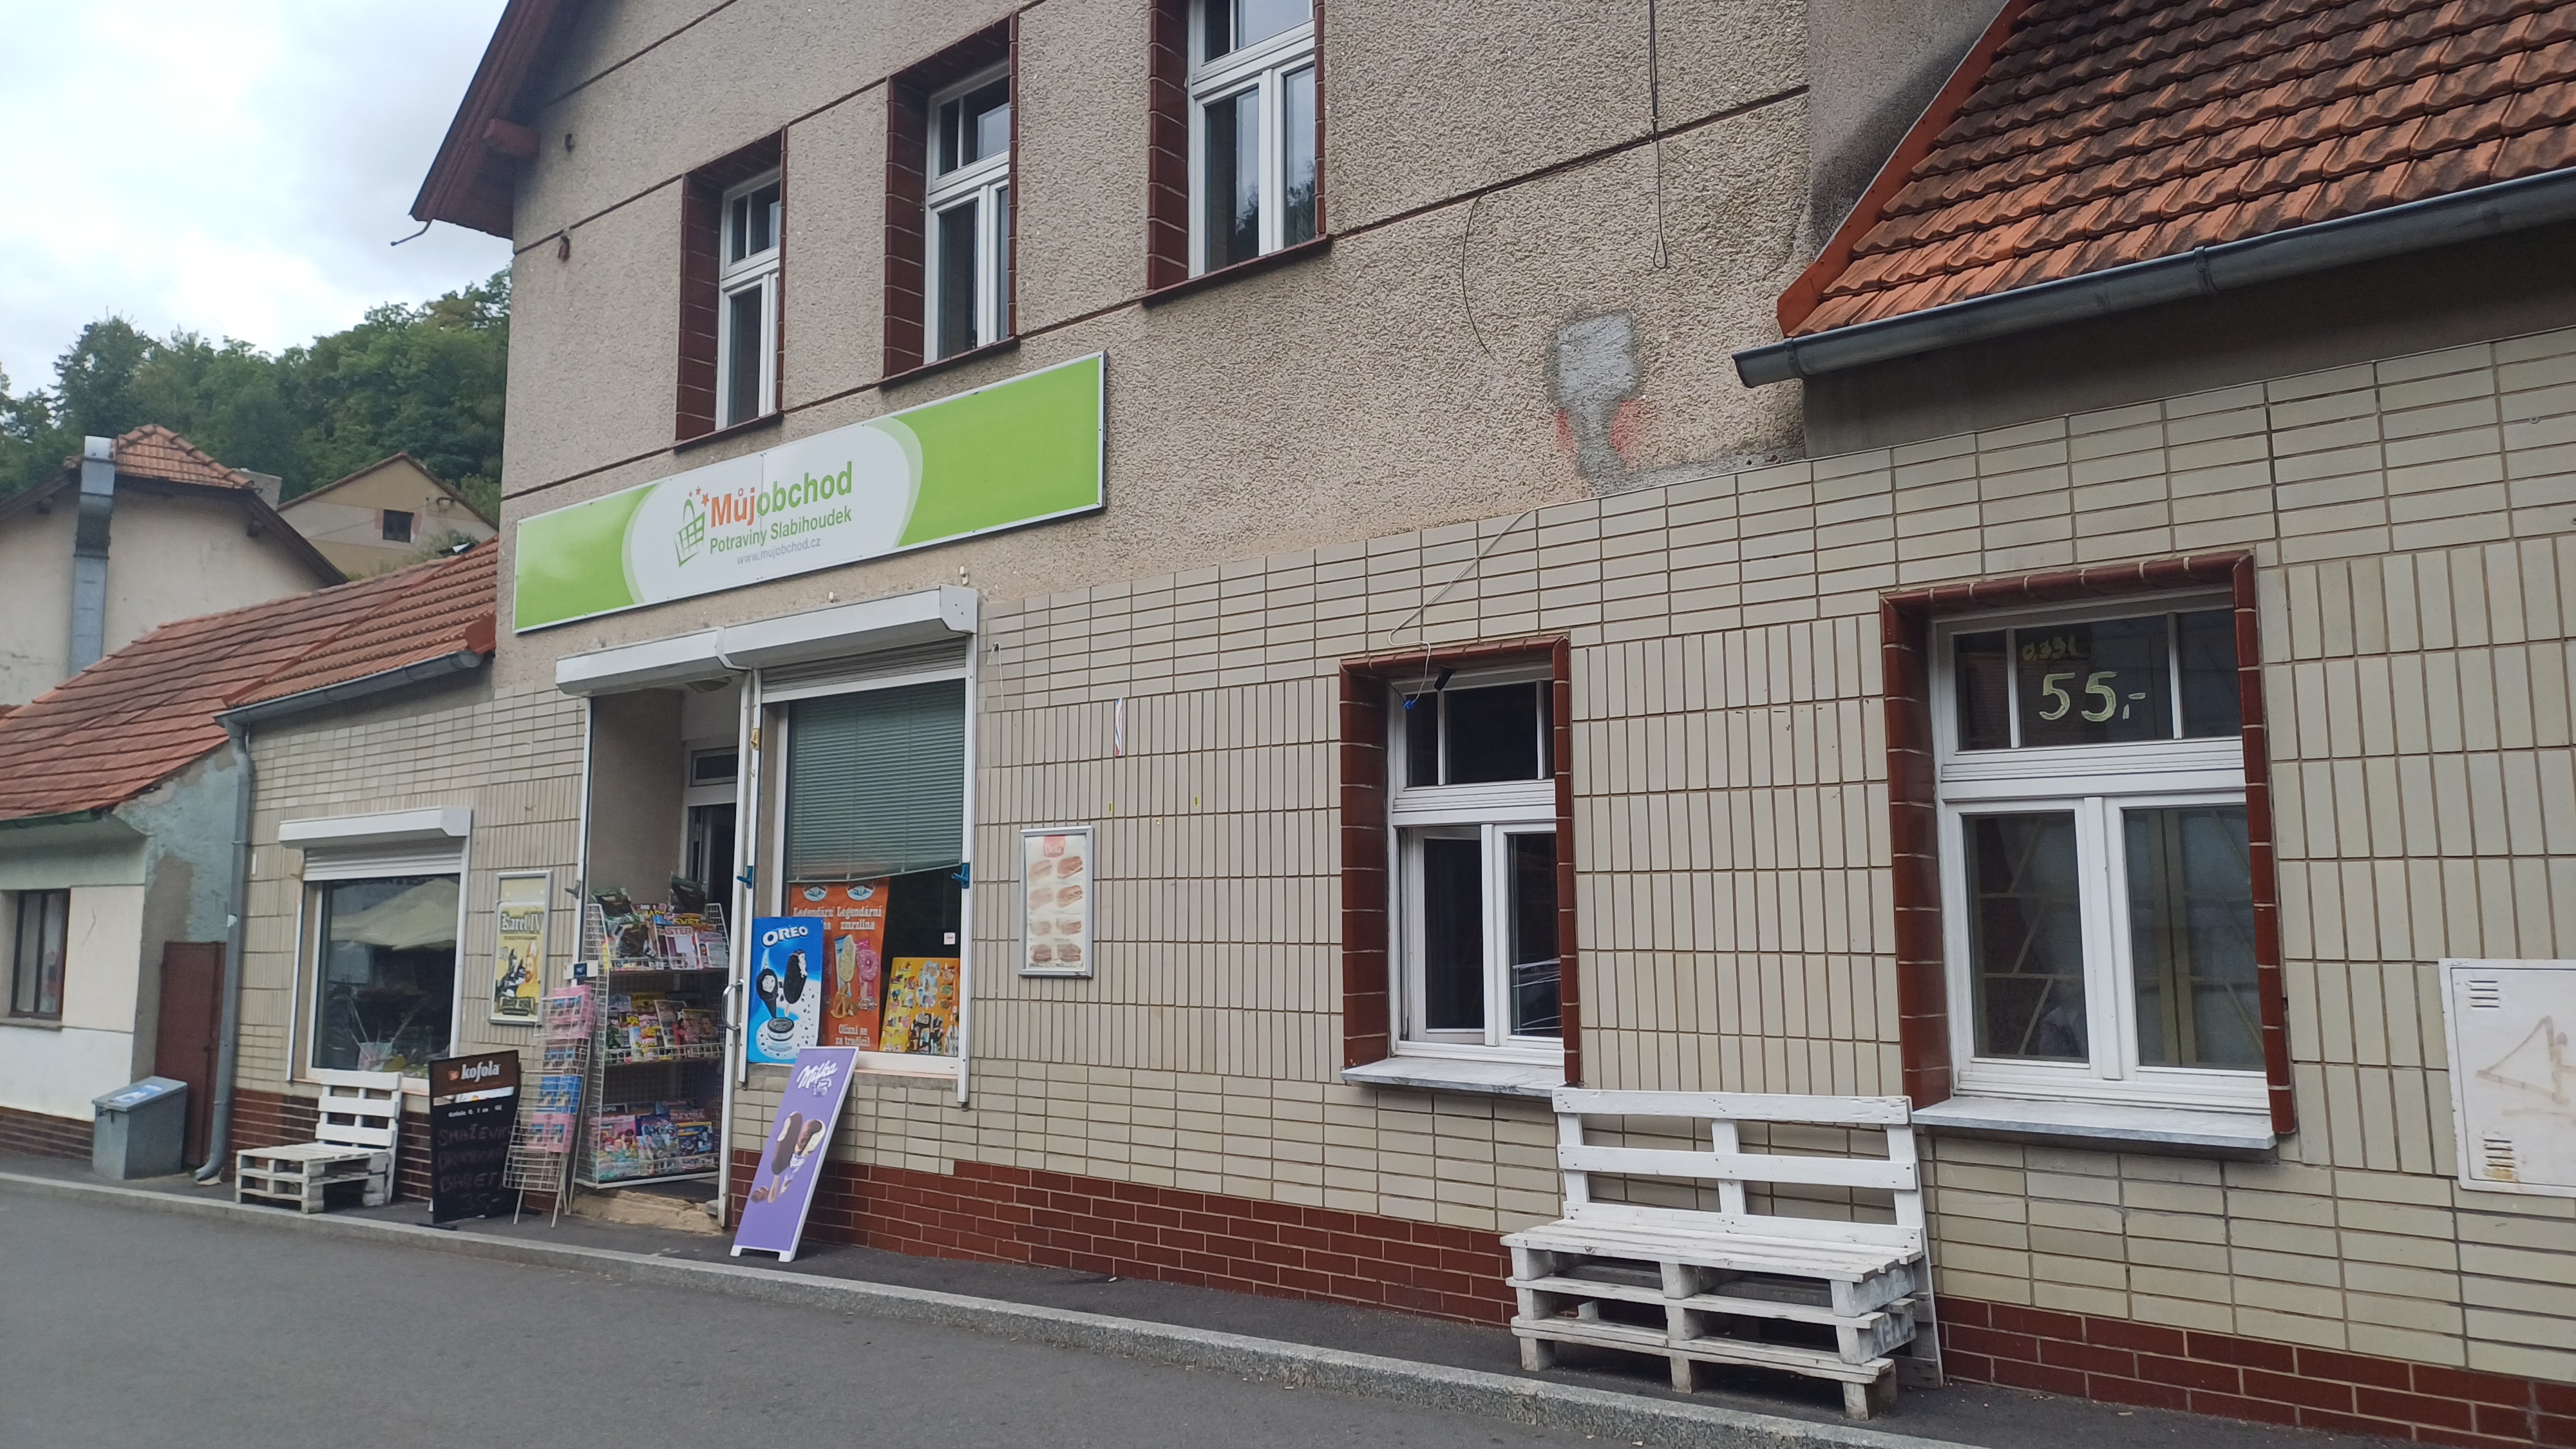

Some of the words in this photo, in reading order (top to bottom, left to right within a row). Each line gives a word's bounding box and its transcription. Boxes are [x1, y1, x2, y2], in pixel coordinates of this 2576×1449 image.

[710, 529, 766, 554] Potraviny
[770, 506, 852, 540] Slabihoudek
[736, 538, 821, 564] www.mujobchod.cz
[837, 905, 882, 920] Legendární
[762, 925, 808, 947] OREO
[460, 1061, 500, 1082] kofola
[796, 1060, 838, 1089] Milka
